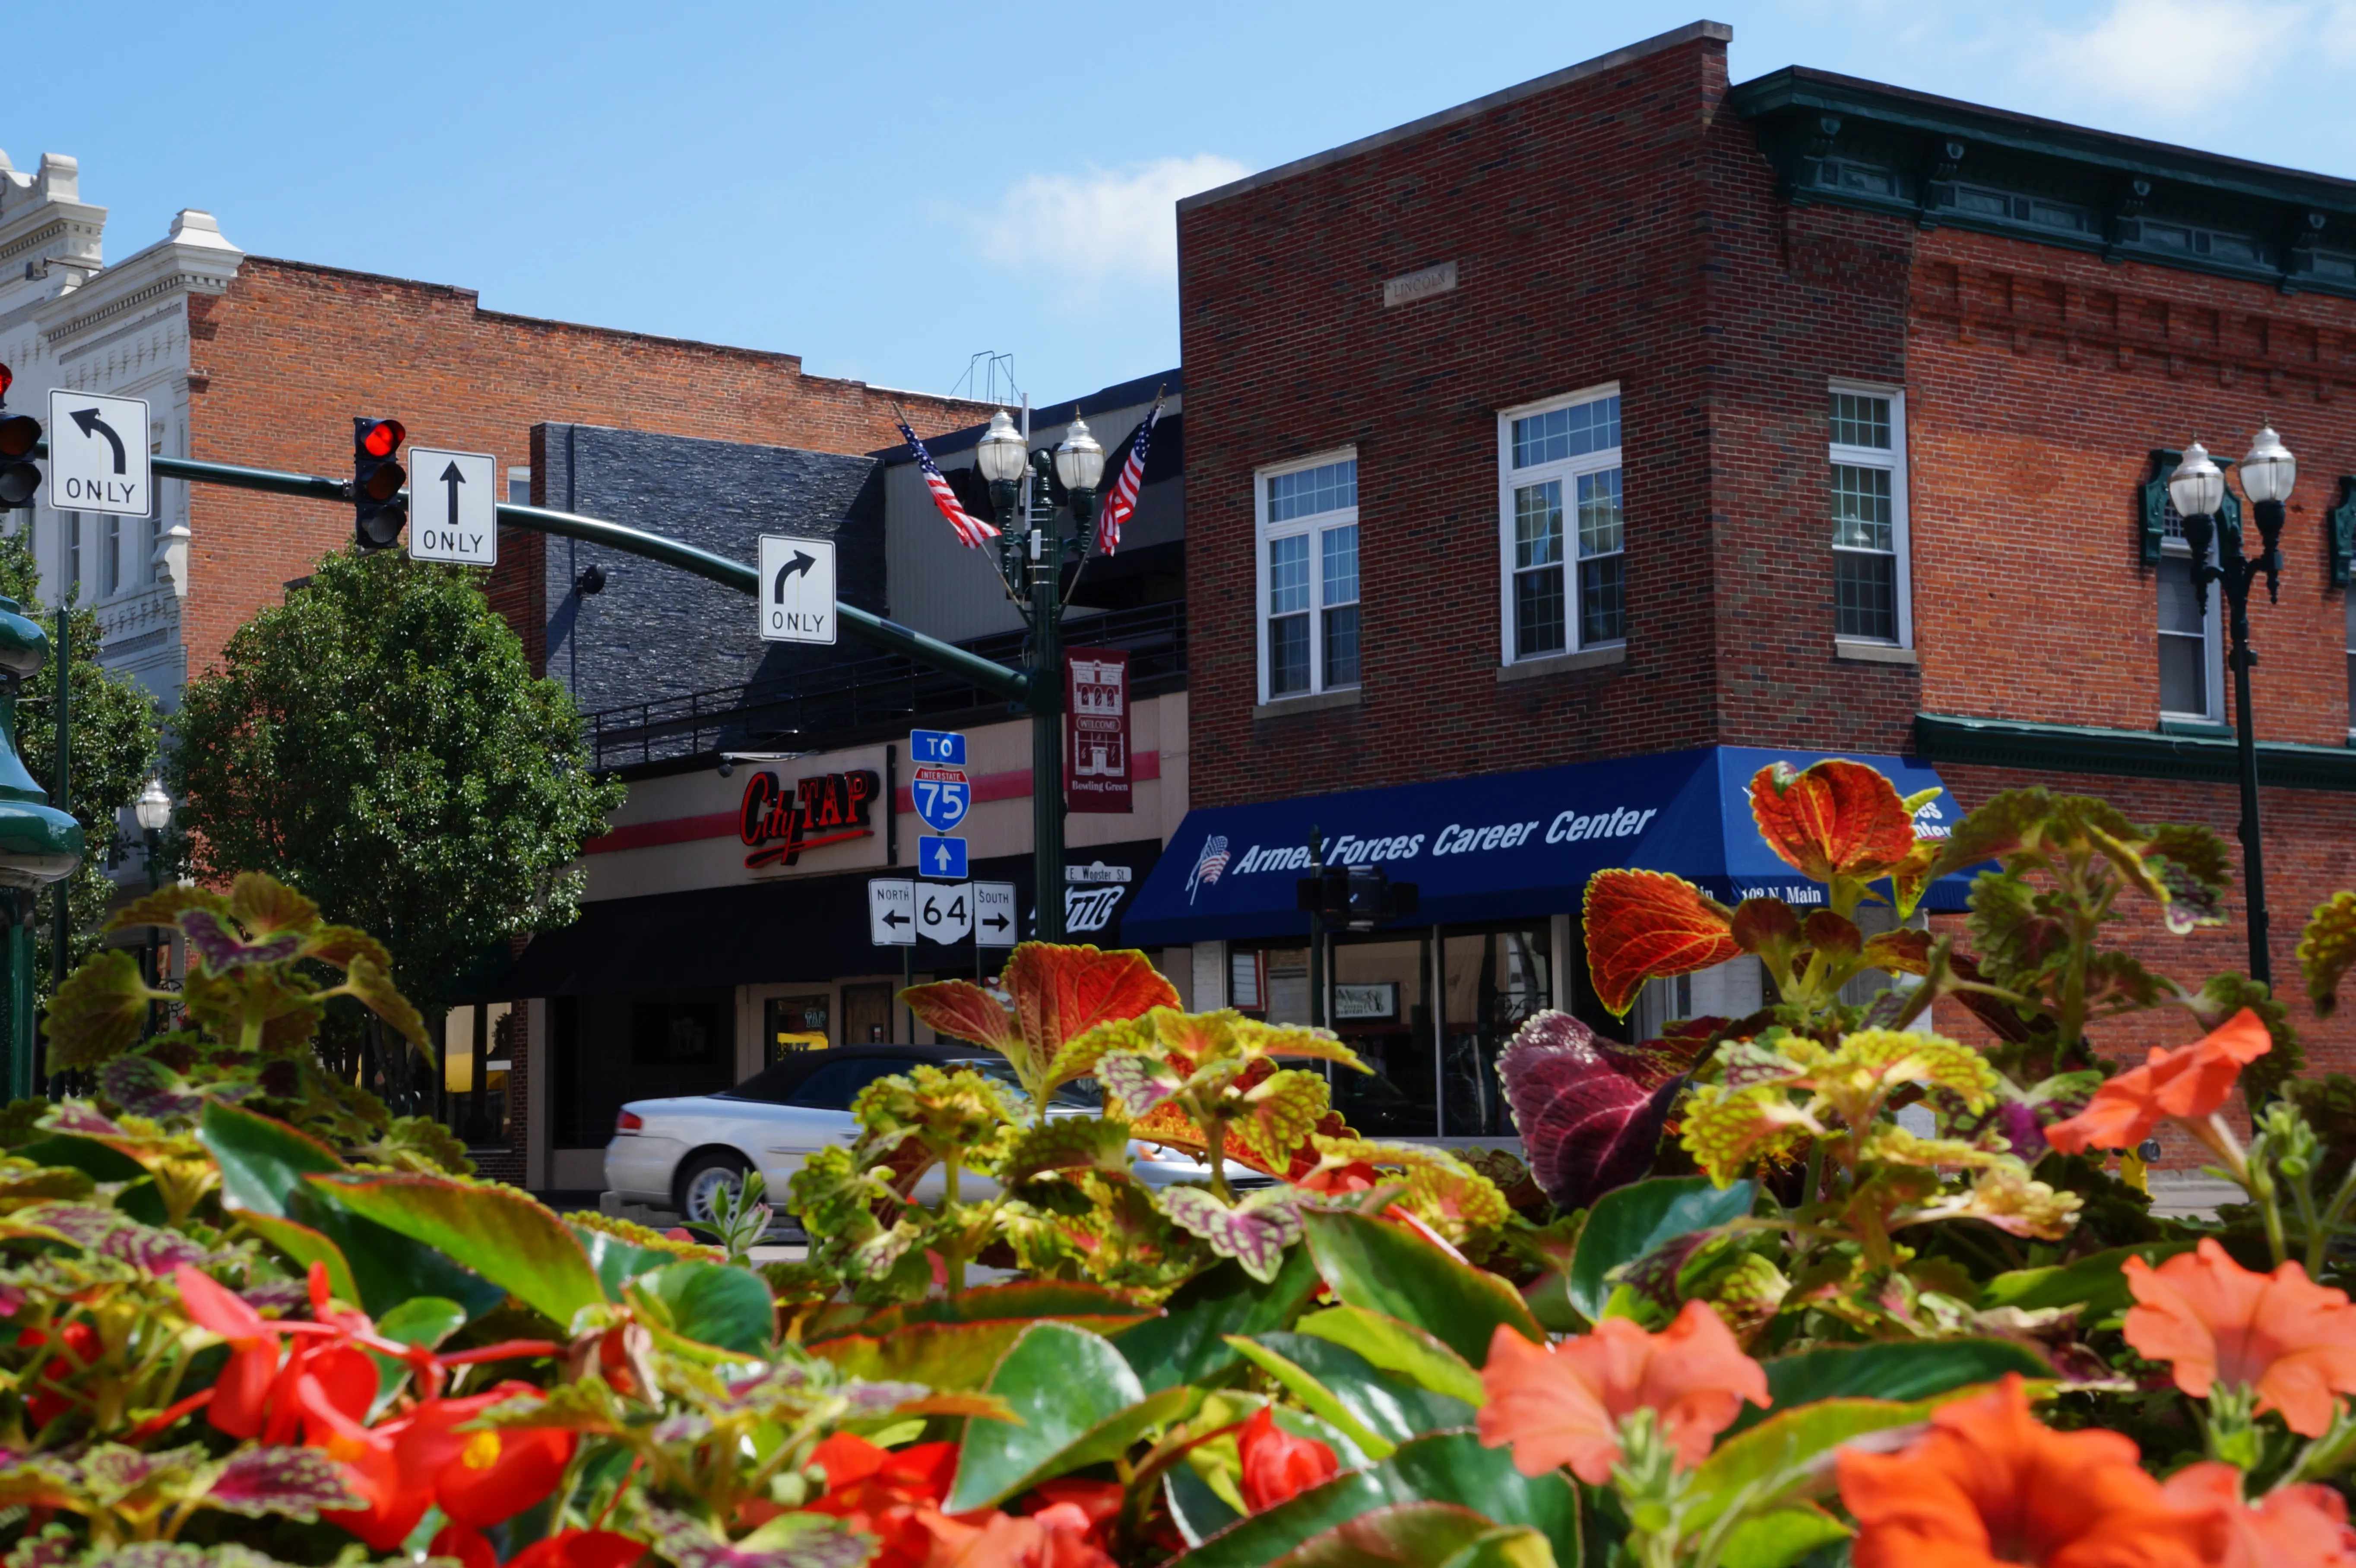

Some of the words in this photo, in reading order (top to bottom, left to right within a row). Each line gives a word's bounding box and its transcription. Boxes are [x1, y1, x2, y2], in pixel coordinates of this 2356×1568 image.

[1394, 273, 1445, 297] LINCOLN
[66, 477, 136, 504] ONLY
[424, 530, 483, 553] ONLY
[772, 611, 824, 633] ONLY
[1080, 720, 1117, 730] WELCOME
[926, 737, 953, 757] TO
[921, 771, 961, 782] INTERSTATE
[1072, 780, 1104, 793] Bowling
[1105, 781, 1128, 791] Green
[918, 783, 963, 820] 75
[740, 771, 799, 865] City
[798, 771, 877, 829] TAP
[1912, 821, 1951, 839] nter
[1232, 838, 1330, 875] Armed
[1325, 834, 1425, 866] Forces
[1432, 820, 1539, 856] Career
[1545, 806, 1657, 844] Center
[1070, 868, 1077, 880] E.
[1083, 867, 1112, 881] Wooster
[1117, 869, 1127, 881] St.
[877, 888, 909, 901] NORTH
[979, 891, 1009, 904] SOUTH
[1786, 886, 1822, 904] Main
[923, 895, 967, 926] 64
[804, 1011, 826, 1028] TAP
